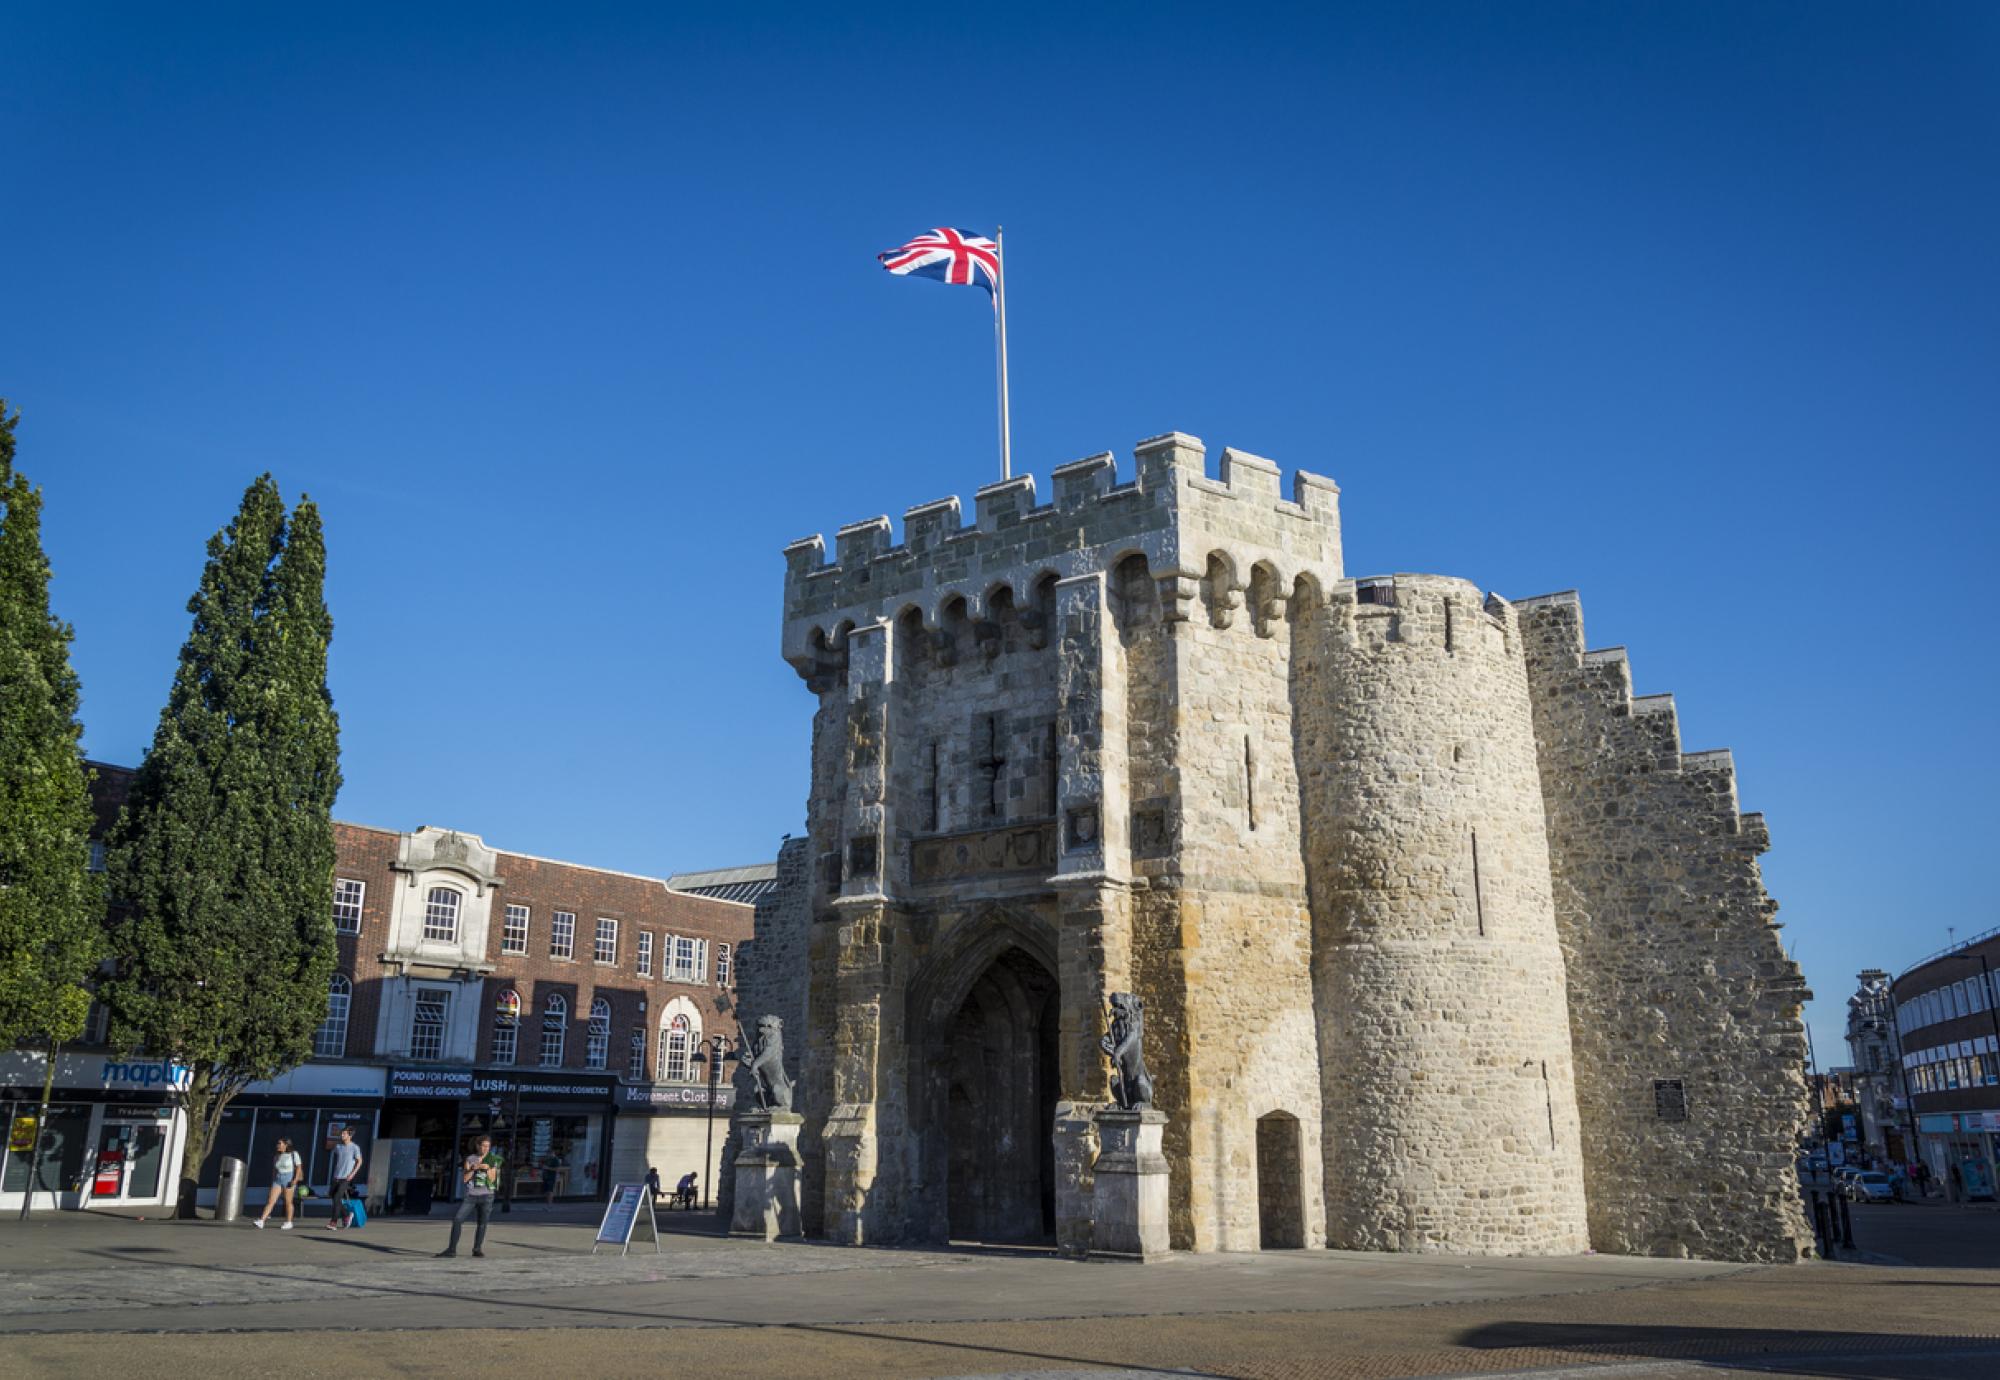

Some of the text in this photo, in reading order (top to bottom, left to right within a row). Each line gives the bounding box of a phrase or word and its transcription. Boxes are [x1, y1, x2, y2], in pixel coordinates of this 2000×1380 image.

[101, 1058, 191, 1088] maplin
[394, 1071, 472, 1083] POUND FOR POUND
[392, 1085, 471, 1096] TRAINING GROUND
[473, 1079, 507, 1091] LUSH
[626, 1087, 680, 1102] Movement
